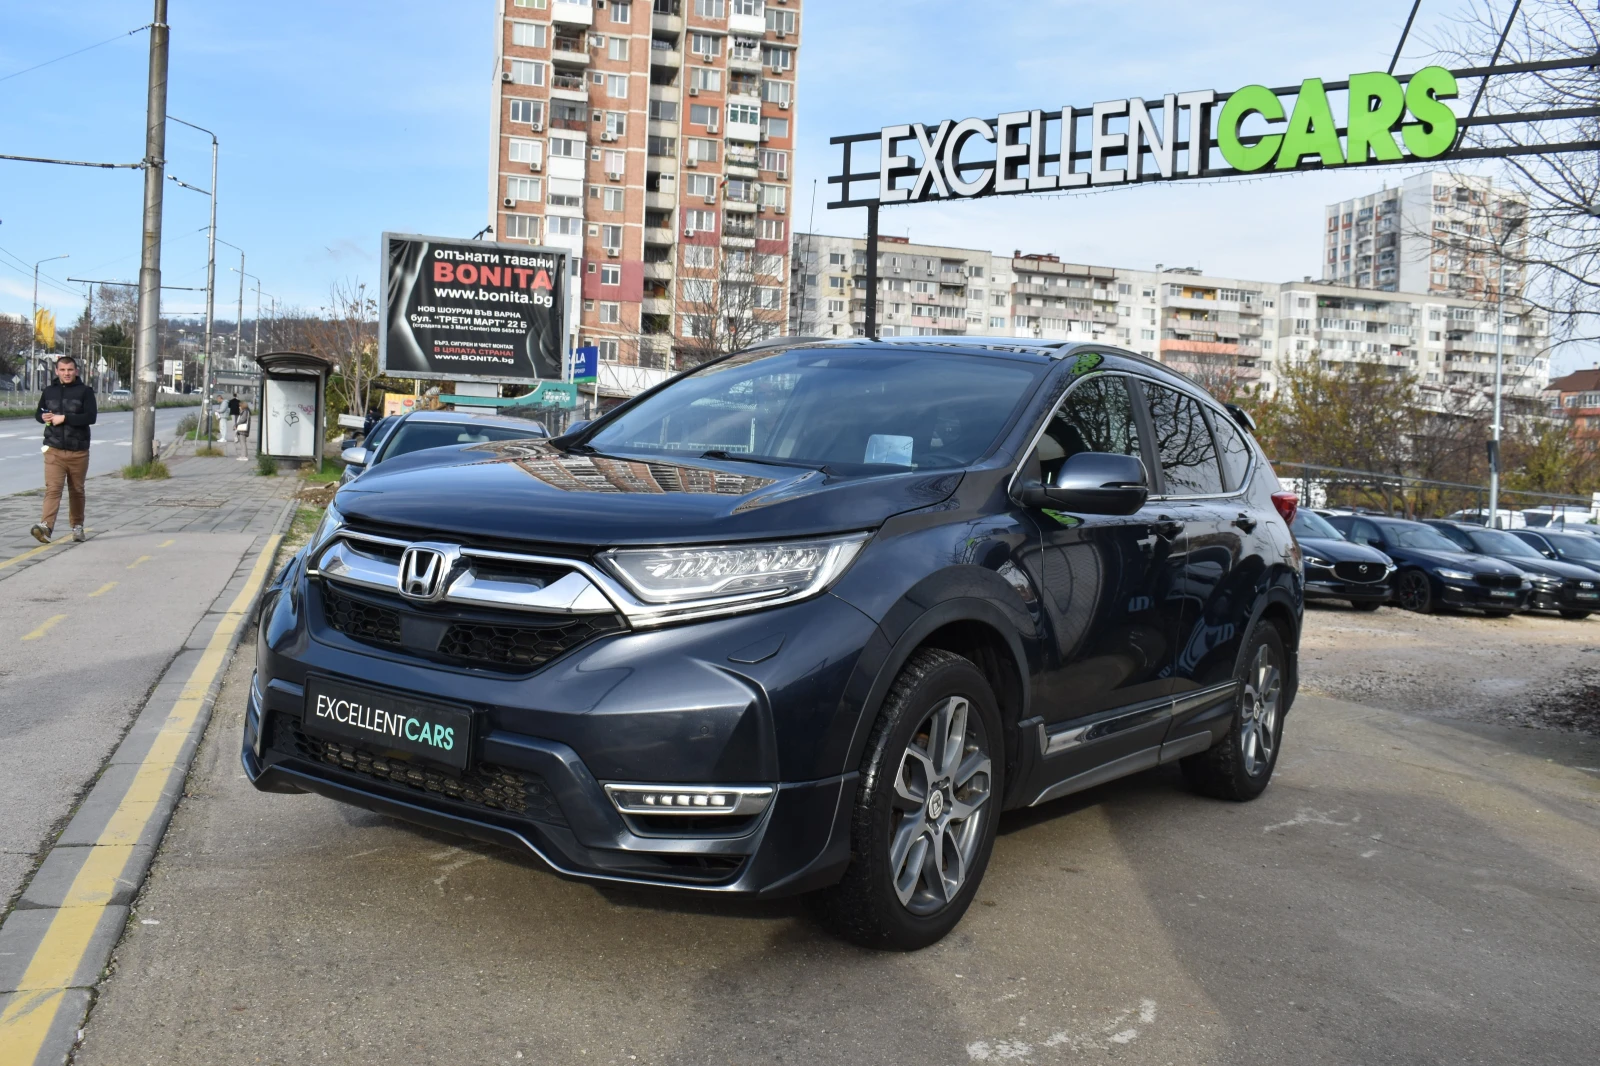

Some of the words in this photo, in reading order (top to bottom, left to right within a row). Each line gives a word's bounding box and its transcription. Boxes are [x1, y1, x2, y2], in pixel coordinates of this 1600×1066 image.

[434, 249, 499, 264] опънати
[503, 255, 554, 268] тавани
[433, 261, 553, 291] BONITA
[434, 287, 553, 307] www.bonita.bg
[417, 305, 435, 313] НОВ
[437, 306, 473, 315] ШОУРУМ
[475, 309, 492, 317] ВЪВ
[494, 310, 521, 319] ВАРНА
[410, 313, 432, 323] бул.
[507, 320, 518, 328] 22
[520, 320, 527, 329] Б
[434, 354, 515, 364] www.BONITA.bg
[442, 347, 477, 355] ЦЯЛАТА
[478, 349, 514, 357] СТРАНА!
